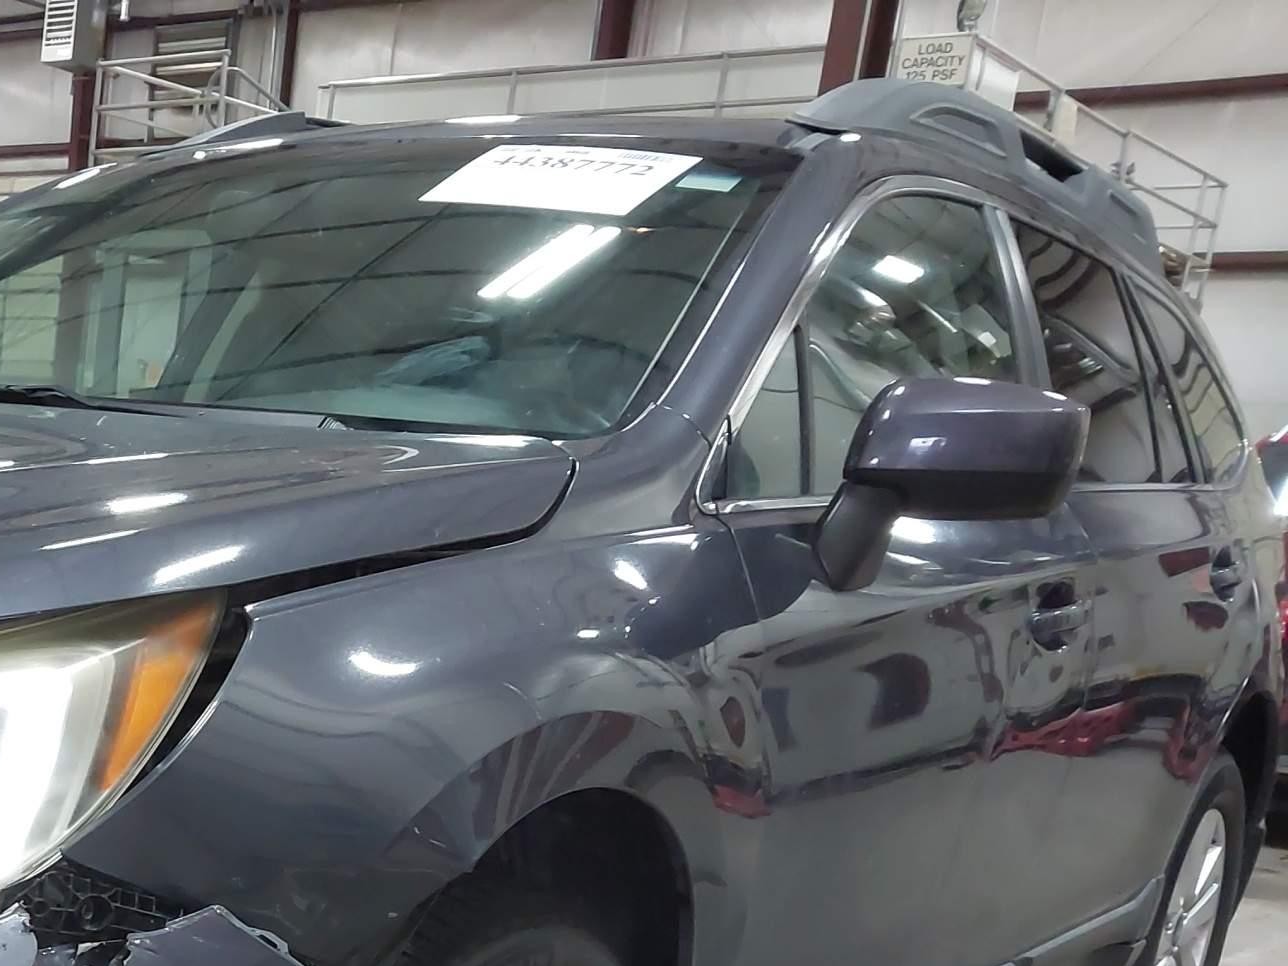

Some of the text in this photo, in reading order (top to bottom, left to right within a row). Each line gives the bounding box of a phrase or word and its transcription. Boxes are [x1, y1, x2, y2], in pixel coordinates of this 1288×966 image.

[918, 42, 953, 55] LOAD
[902, 55, 966, 69] CAPACITY
[906, 68, 958, 81] 125 PSF
[493, 155, 655, 176] 44387772
